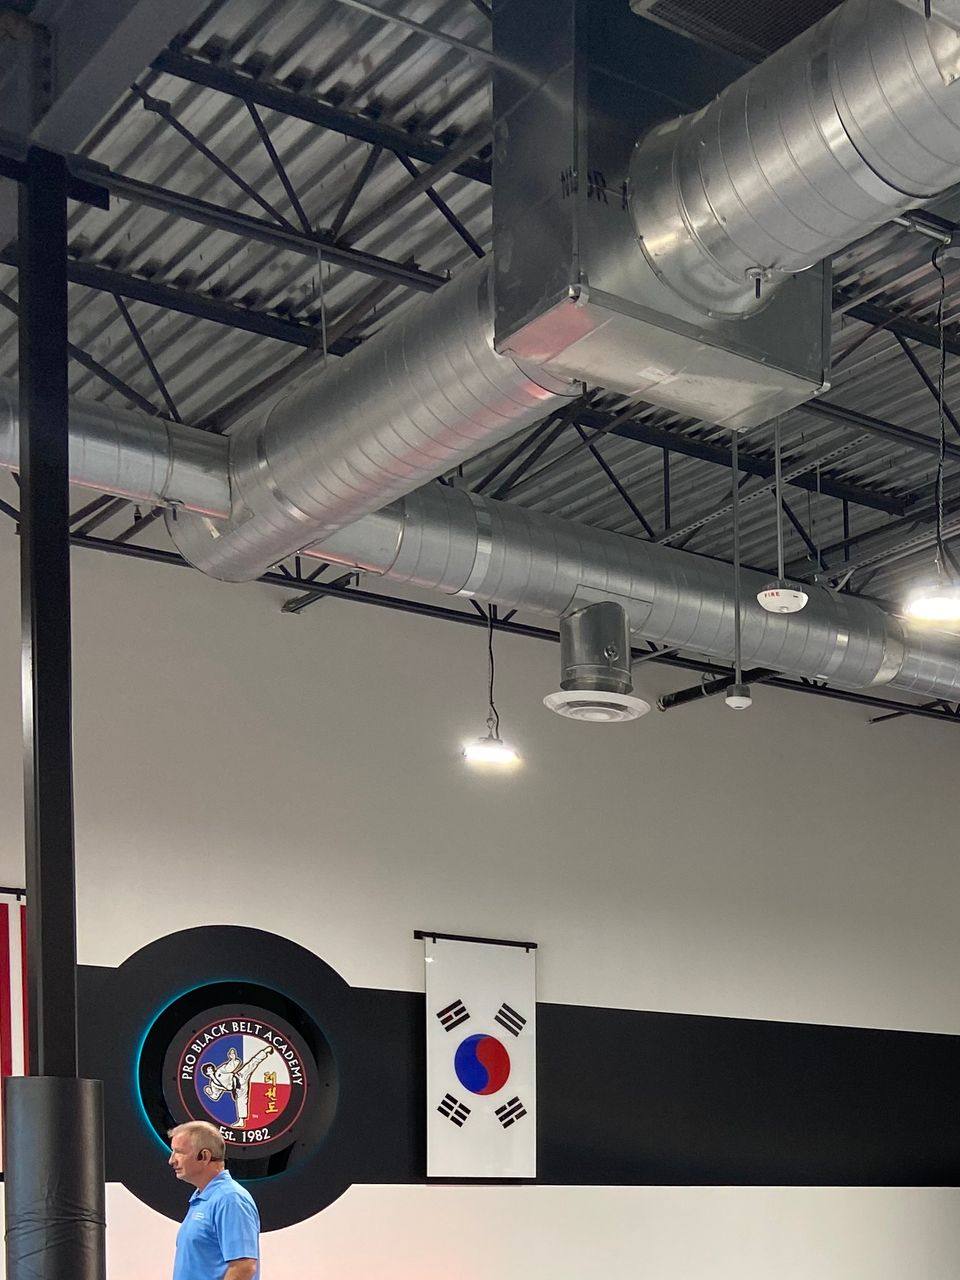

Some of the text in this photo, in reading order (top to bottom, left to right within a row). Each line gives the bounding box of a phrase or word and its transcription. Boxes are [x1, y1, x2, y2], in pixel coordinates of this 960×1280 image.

[182, 1021, 304, 1085] PRO BLACK BELT ACADEMY
[242, 1127, 271, 1142] 1982
